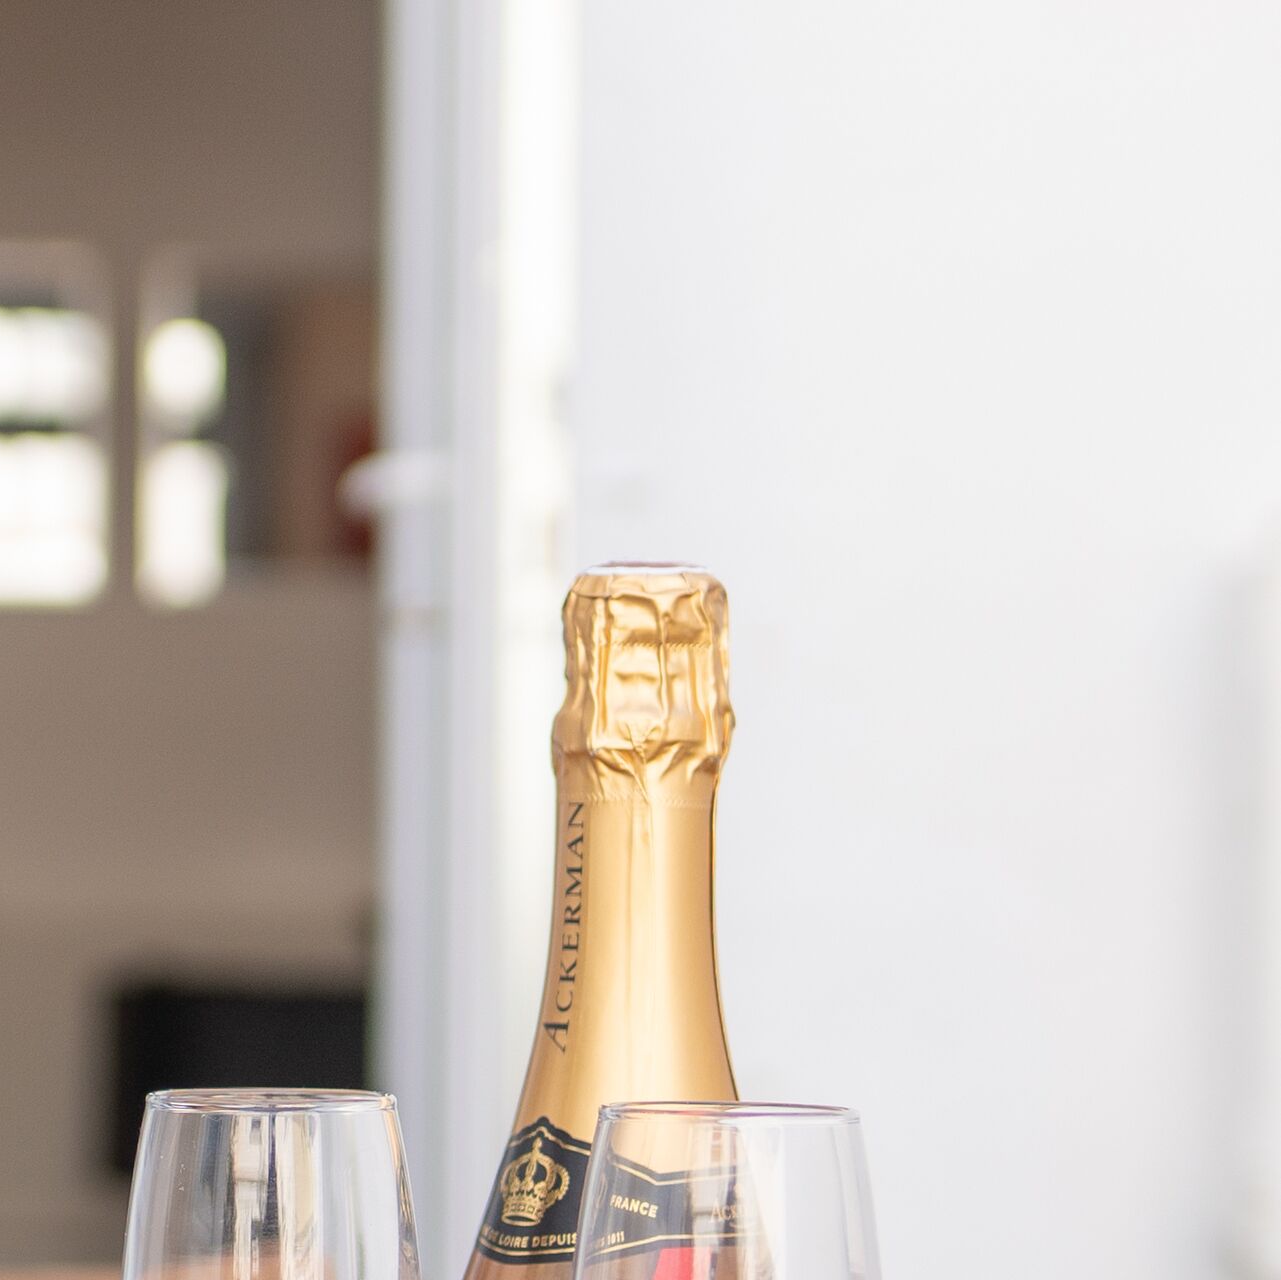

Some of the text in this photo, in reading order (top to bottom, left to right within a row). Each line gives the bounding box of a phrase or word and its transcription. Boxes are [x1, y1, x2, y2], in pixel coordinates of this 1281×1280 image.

[542, 799, 585, 1055] ACKERMAN
[609, 1194, 658, 1218] FRANCE
[498, 1233, 529, 1249] LOIRE
[531, 1232, 577, 1248] DEPUIS
